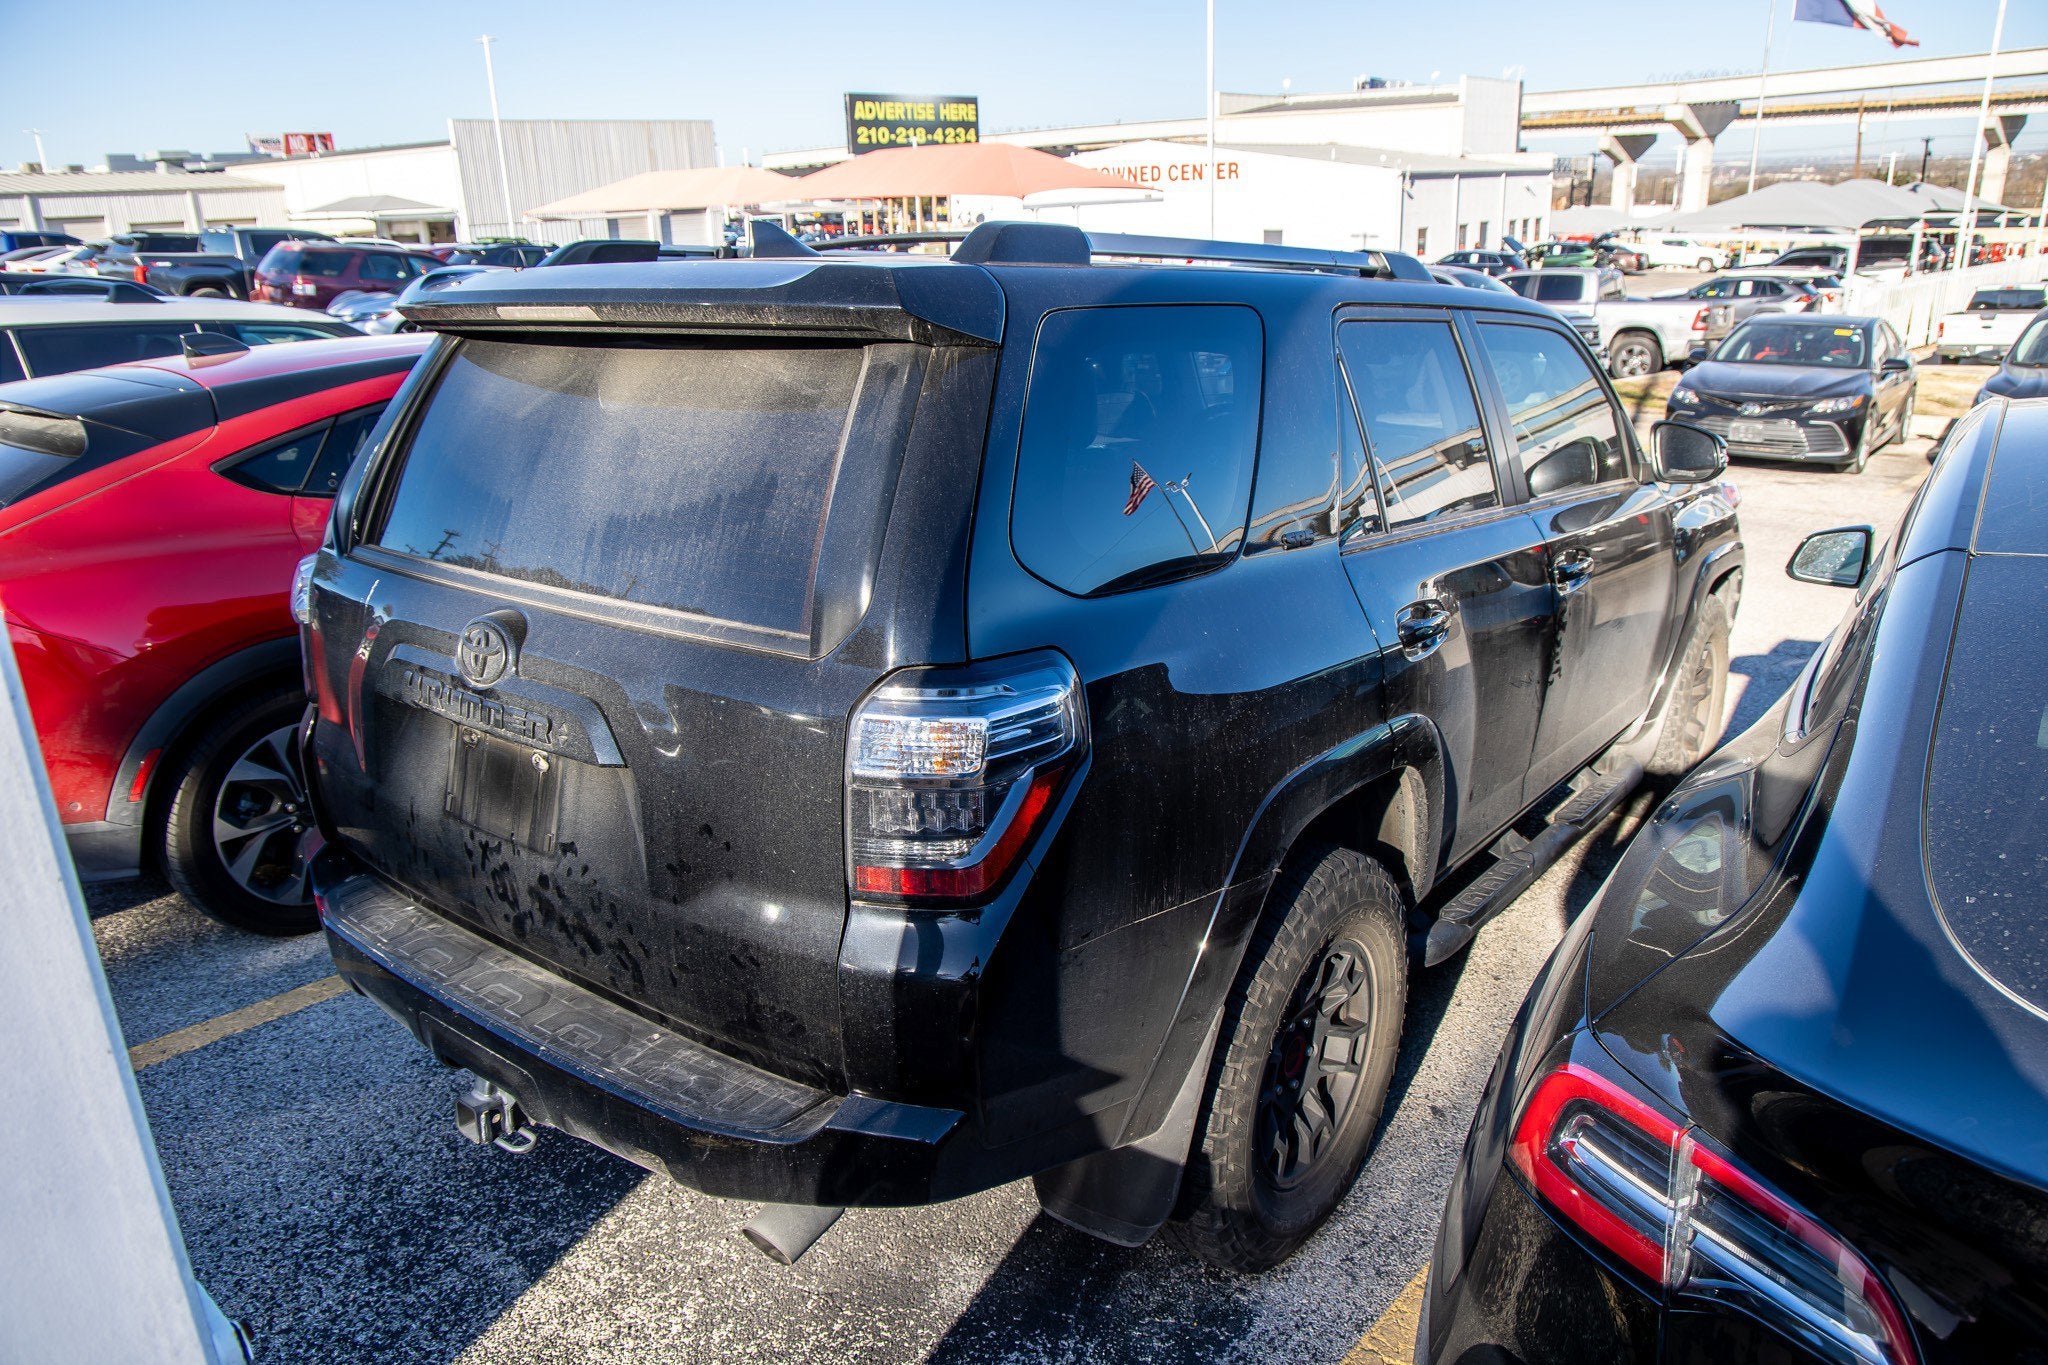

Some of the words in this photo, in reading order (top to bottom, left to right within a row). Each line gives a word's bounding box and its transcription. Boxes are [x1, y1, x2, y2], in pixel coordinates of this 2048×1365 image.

[854, 100, 936, 121] ADVERTISE
[940, 102, 978, 122] HERE
[856, 126, 978, 145] 210-218-4234
[1168, 162, 1239, 181] CENER
